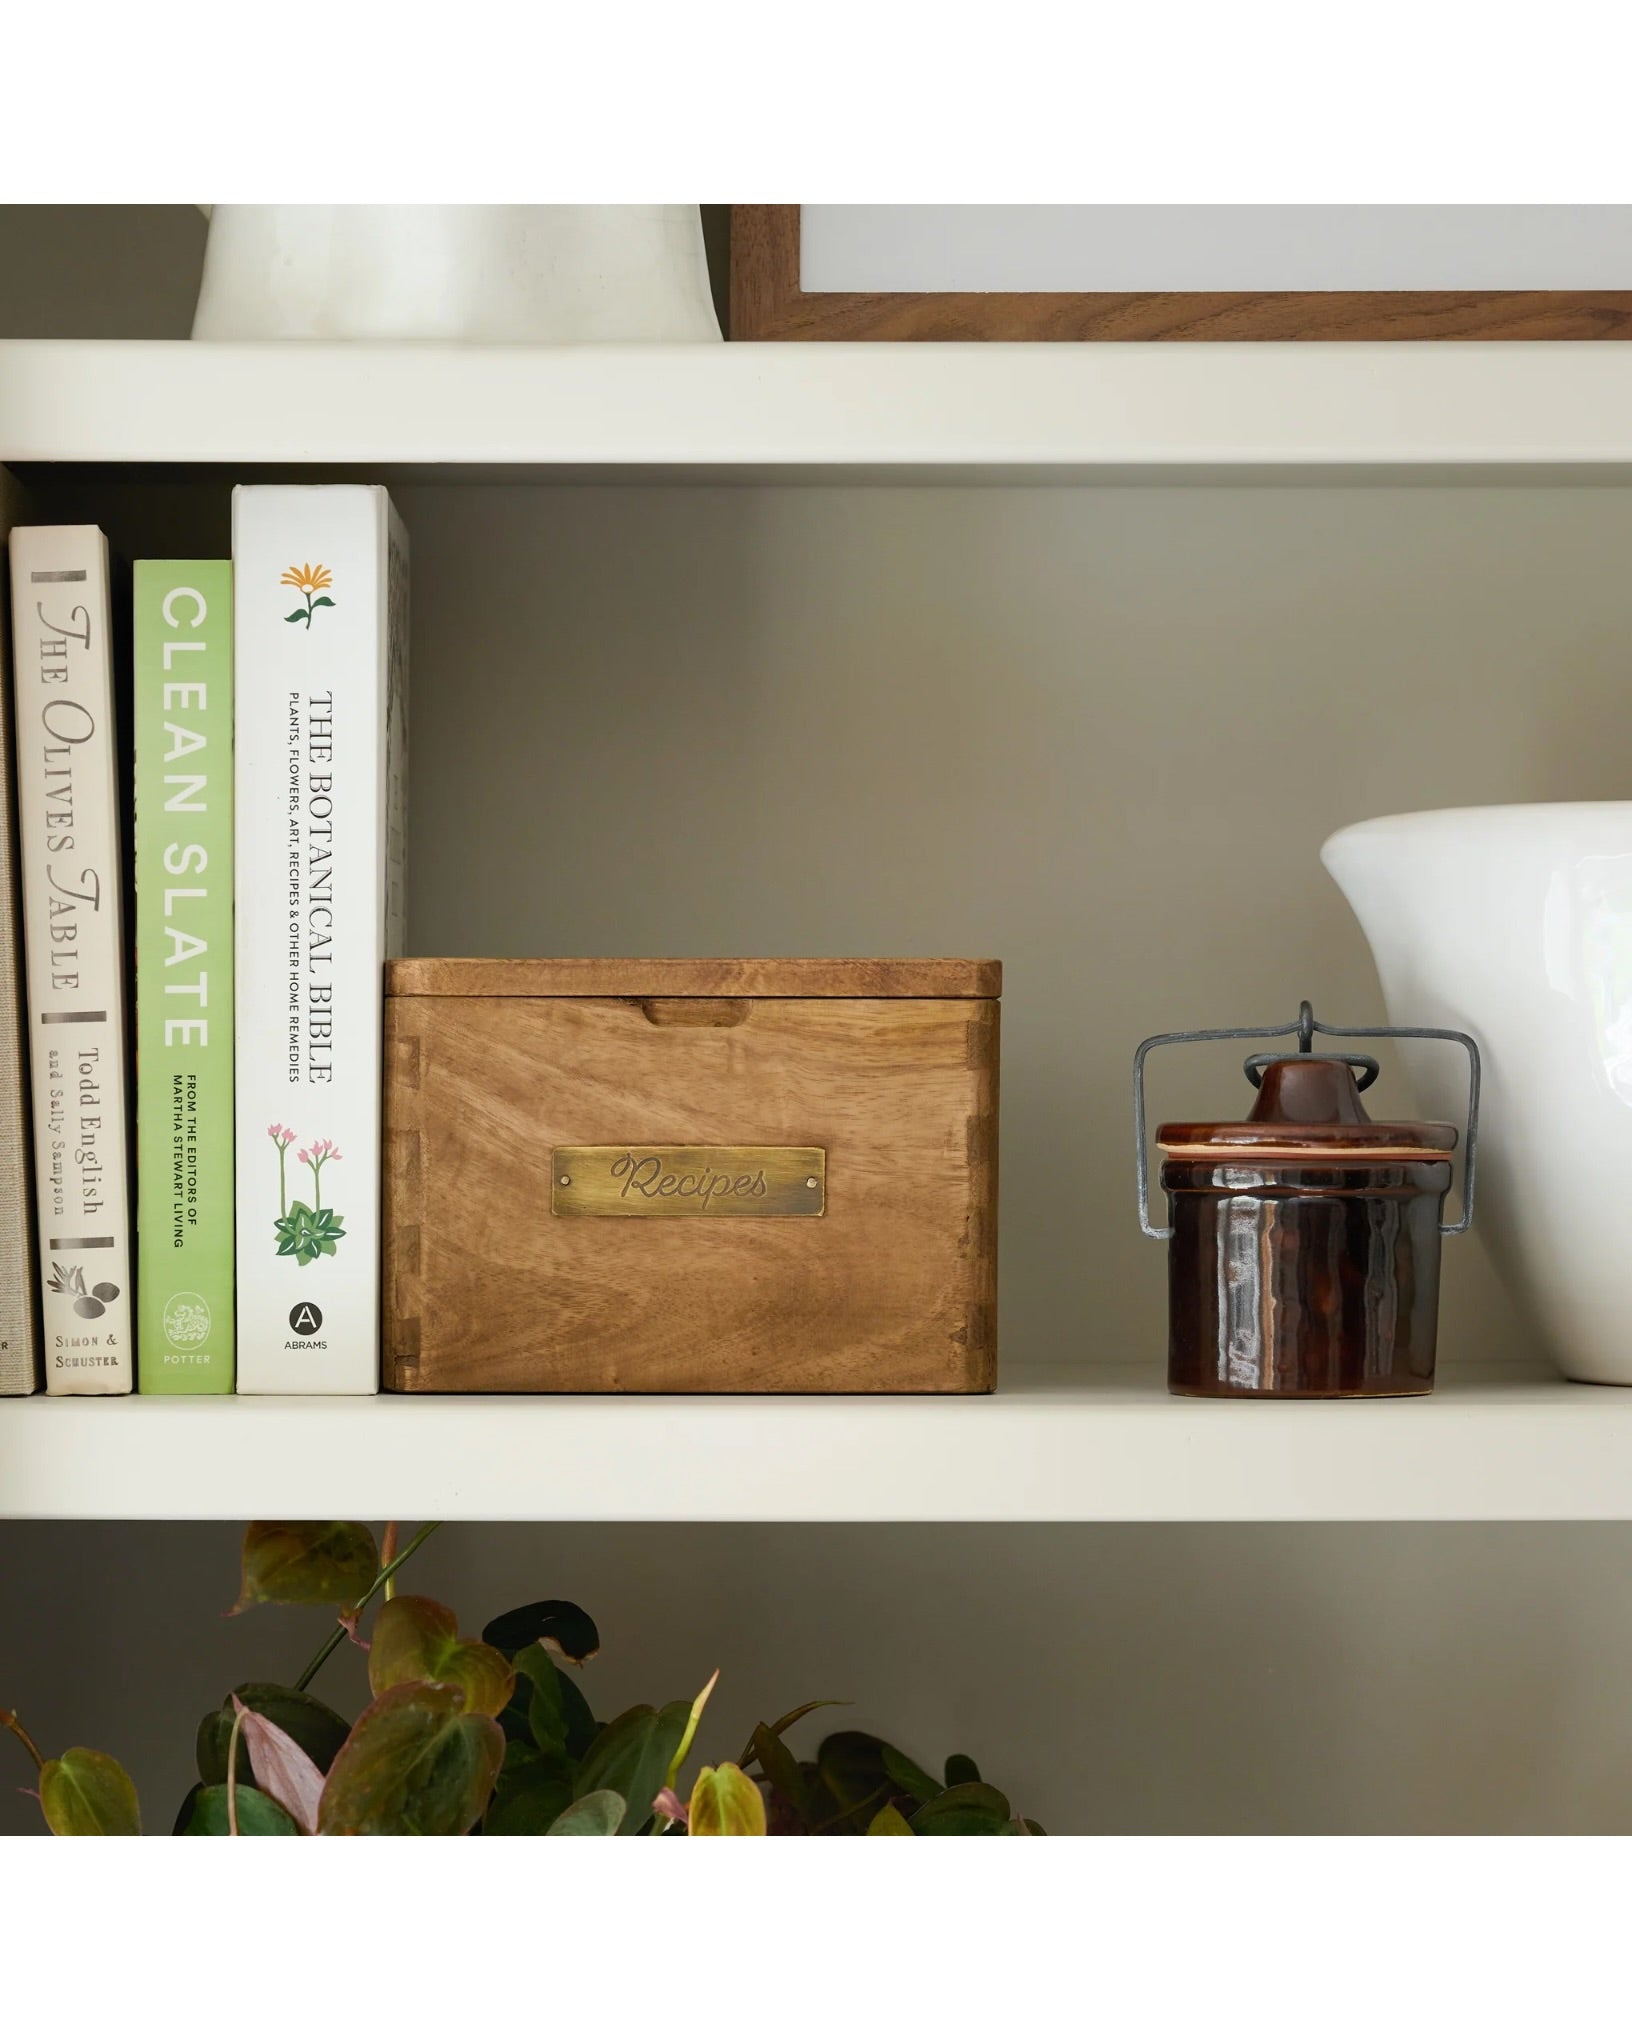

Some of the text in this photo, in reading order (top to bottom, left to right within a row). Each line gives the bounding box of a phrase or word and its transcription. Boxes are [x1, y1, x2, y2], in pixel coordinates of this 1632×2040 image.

[41, 700, 95, 853] OLIVES
[162, 587, 208, 1047] CLEAN SLATE
[287, 692, 300, 1083] PLANTS, FLOWERS, ART, RECIPES & OTHER HOME REMEDIES
[308, 690, 334, 1084] THE BOTANICAL BIBLE
[48, 1050, 65, 1216] and Sally Sampson
[74, 1048, 104, 1216] Todd English
[173, 1074, 184, 1248] MARTHA STEWART LIVING
[187, 1074, 197, 1225] FROM THE EDITORS OF
[609, 1152, 768, 1210] Recipes
[106, 1333, 119, 1346] &
[163, 1355, 211, 1365] POTTER
[284, 1341, 328, 1350] ABRAMS
